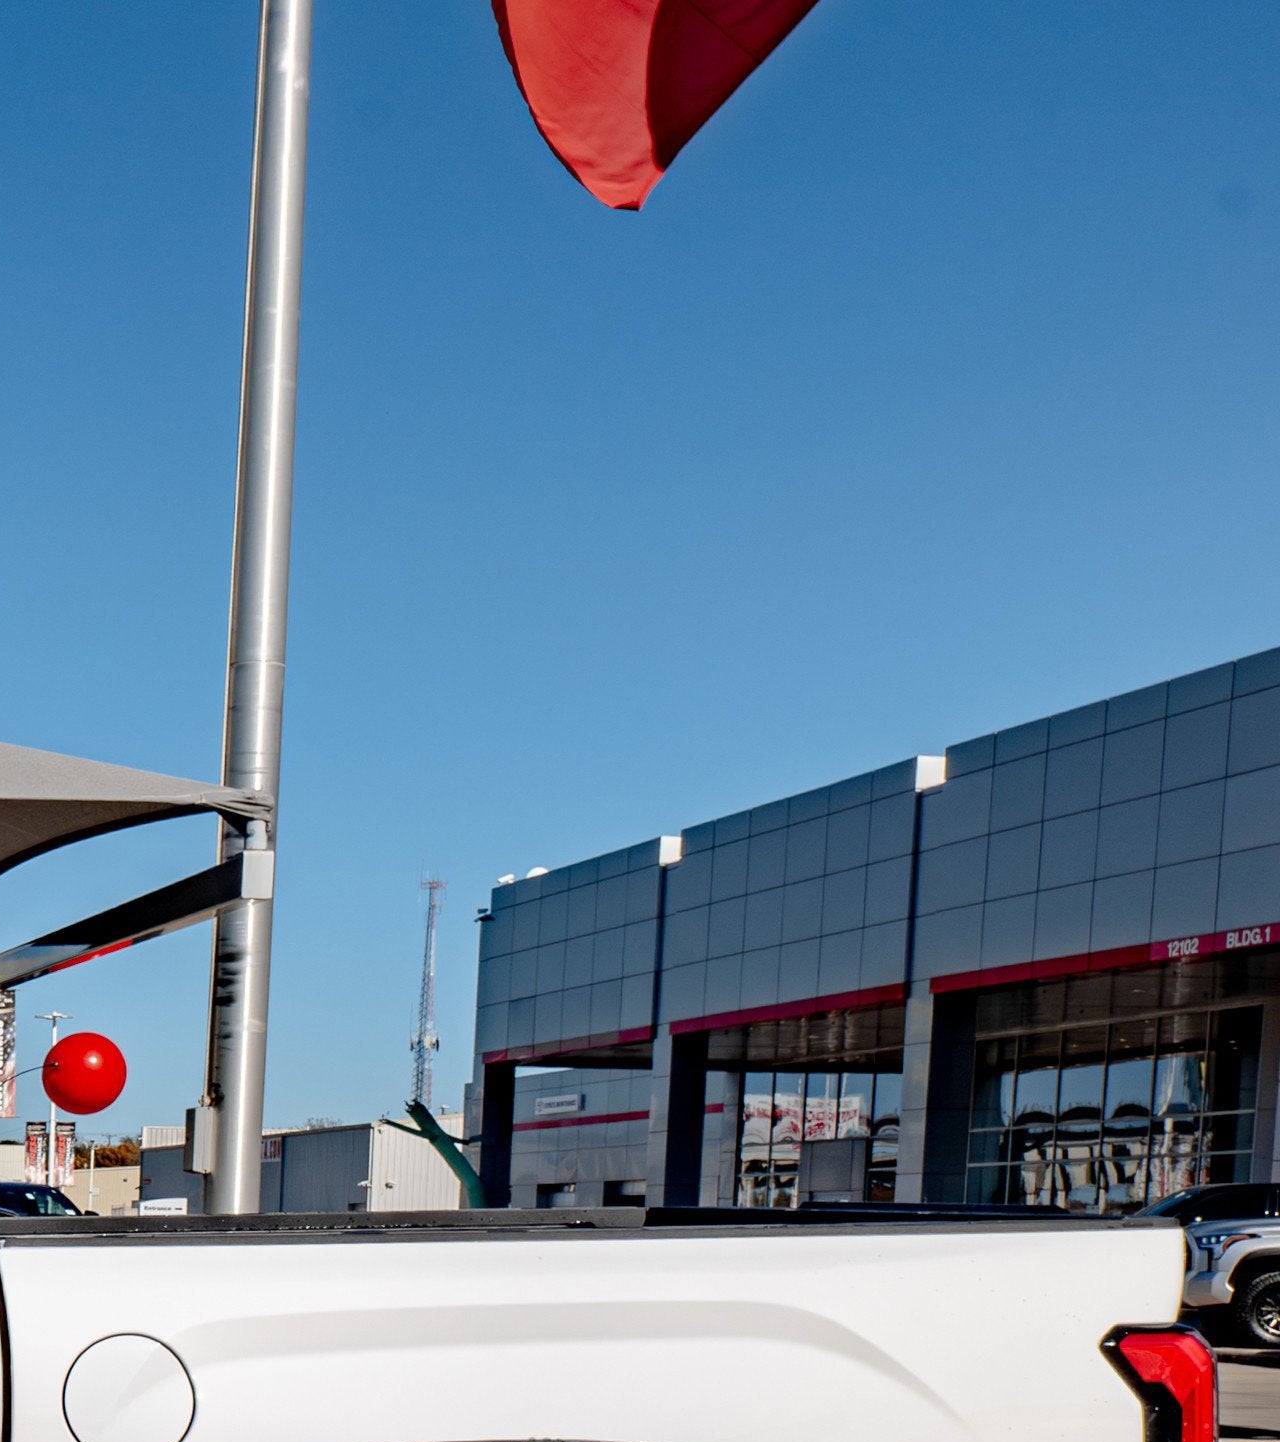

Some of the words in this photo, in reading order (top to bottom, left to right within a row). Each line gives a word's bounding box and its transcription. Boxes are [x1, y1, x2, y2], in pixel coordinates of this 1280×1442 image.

[1167, 938, 1199, 957] 12102
[1226, 928, 1263, 949] BLDG.
[1264, 926, 1271, 943] 1
